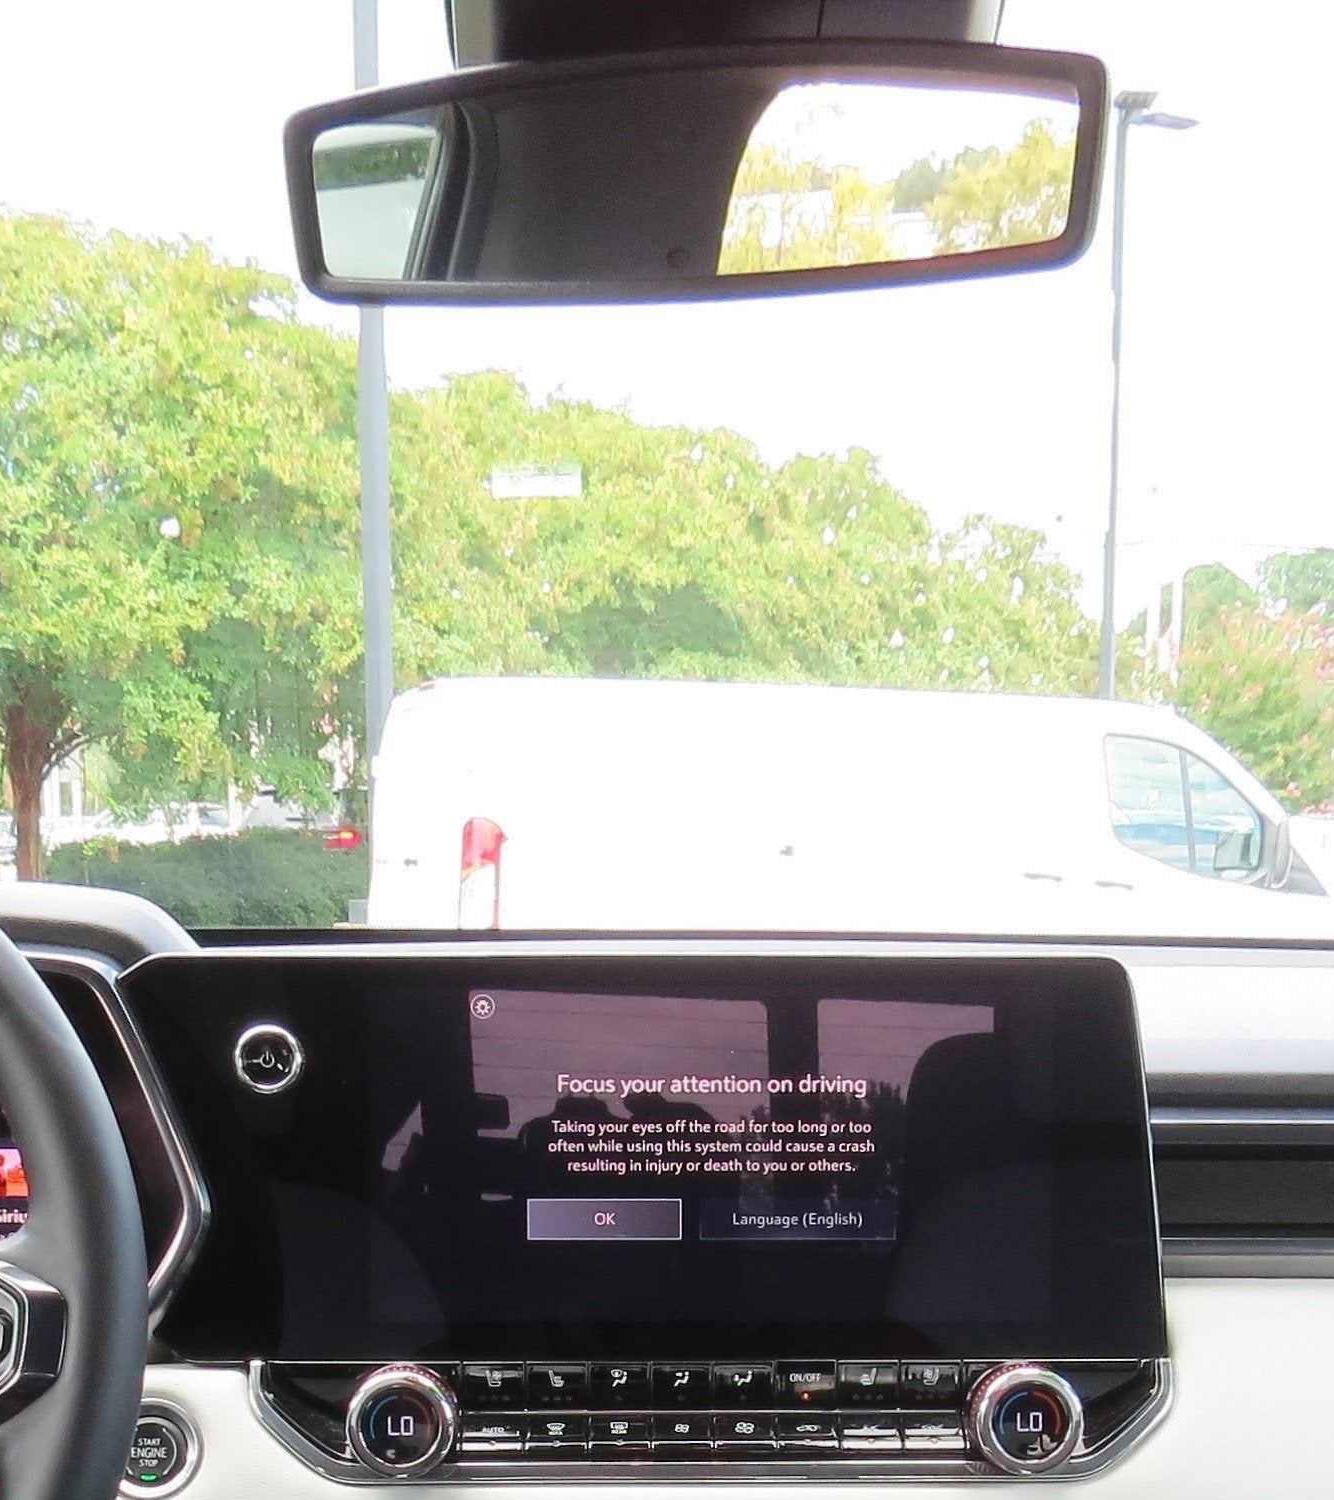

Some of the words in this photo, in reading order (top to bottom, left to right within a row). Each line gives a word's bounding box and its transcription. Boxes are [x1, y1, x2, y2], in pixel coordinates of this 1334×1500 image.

[557, 1074, 616, 1093] Focus
[621, 1079, 665, 1098] your
[670, 1075, 762, 1093] attention
[768, 1078, 793, 1093] on
[798, 1074, 867, 1098] driving
[552, 1120, 595, 1137] Taking
[598, 1123, 629, 1137] your
[632, 1123, 663, 1137] eyes
[666, 1120, 687, 1133] off
[689, 1120, 711, 1133] the
[714, 1120, 745, 1133] road
[748, 1120, 768, 1133] for
[771, 1121, 794, 1133] too
[797, 1120, 827, 1137] long
[831, 1123, 846, 1133] or
[848, 1121, 872, 1133] too
[548, 1139, 585, 1152] often
[587, 1139, 624, 1152] while
[627, 1139, 663, 1156] using
[667, 1139, 692, 1152] this
[695, 1140, 742, 1156] system
[745, 1139, 782, 1152] could
[785, 1142, 824, 1152] cause
[827, 1142, 836, 1152] a
[839, 1139, 875, 1152] crash
[567, 1158, 626, 1175] resulting
[630, 1158, 642, 1171] in
[645, 1158, 683, 1175] injury
[686, 1162, 701, 1171] or
[704, 1158, 743, 1171] death
[746, 1159, 760, 1171] to
[762, 1162, 788, 1175] you
[791, 1162, 805, 1171] or
[808, 1158, 856, 1172] others.
[594, 1212, 616, 1226] OK
[732, 1212, 799, 1229] Language
[802, 1212, 863, 1229] (English)
[789, 1373, 821, 1383] ON/OFF
[387, 1415, 414, 1437] LO
[1016, 1411, 1043, 1433] LO
[138, 1438, 161, 1446] START
[130, 1447, 167, 1459] ENGINE
[139, 1459, 159, 1467] STOP
